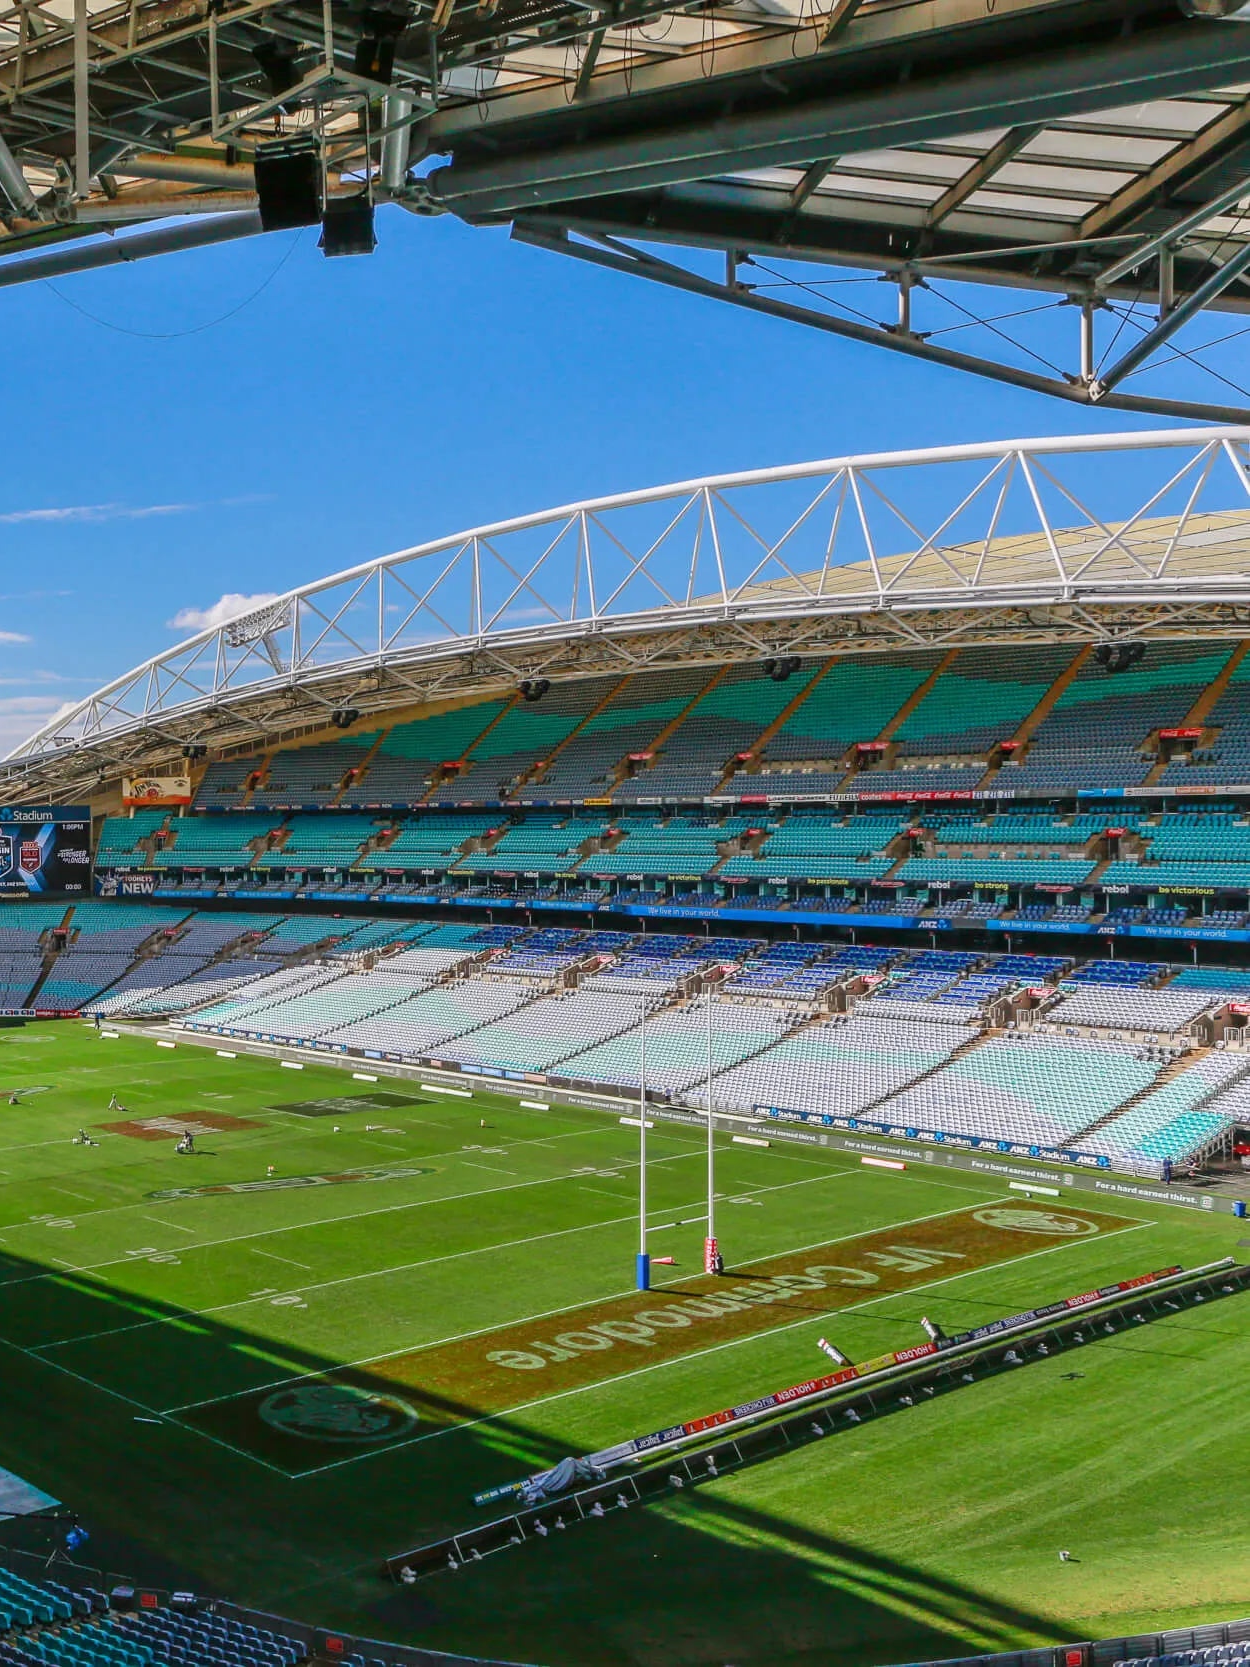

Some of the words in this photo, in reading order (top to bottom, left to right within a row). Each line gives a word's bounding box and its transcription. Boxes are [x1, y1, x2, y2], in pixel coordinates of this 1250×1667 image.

[13, 810, 53, 821] Stadium
[122, 883, 154, 894] NEW
[928, 881, 950, 889] rebel
[984, 882, 1009, 890] strong
[1102, 884, 1129, 894] rebel
[1158, 886, 1170, 894] be
[1171, 886, 1214, 895] victorious
[648, 907, 659, 915] We
[660, 907, 672, 915] live
[681, 910, 698, 918] your
[699, 910, 720, 918] world.
[1145, 927, 1158, 935] We
[1159, 927, 1172, 935] live
[1174, 928, 1182, 936] in
[1202, 929, 1229, 938] world.
[755, 1107, 770, 1115] ANZ
[916, 1132, 935, 1141] ANZ
[944, 1136, 972, 1146] Stadium
[862, 1142, 876, 1150] hard
[877, 1146, 900, 1155] earned
[901, 1148, 922, 1158] thirst.
[978, 1140, 998, 1150] ANZ
[1010, 1145, 1030, 1155] ANZ
[1038, 1149, 1070, 1161] Stadium
[1076, 1155, 1098, 1166] ANZ
[971, 1160, 984, 1168] For
[990, 1162, 1008, 1173] hard
[1008, 1166, 1036, 1178] earned
[1036, 1170, 1060, 1182] thirst.
[1096, 1181, 1109, 1190] For
[1117, 1184, 1138, 1194] hard
[1138, 1189, 1168, 1200] earned
[1170, 1194, 1198, 1204] thirst.
[863, 1245, 967, 1273] VF
[486, 1265, 880, 1371] Commodore
[896, 1345, 929, 1360] HOLDEN
[777, 1384, 810, 1401] HOLDEN
